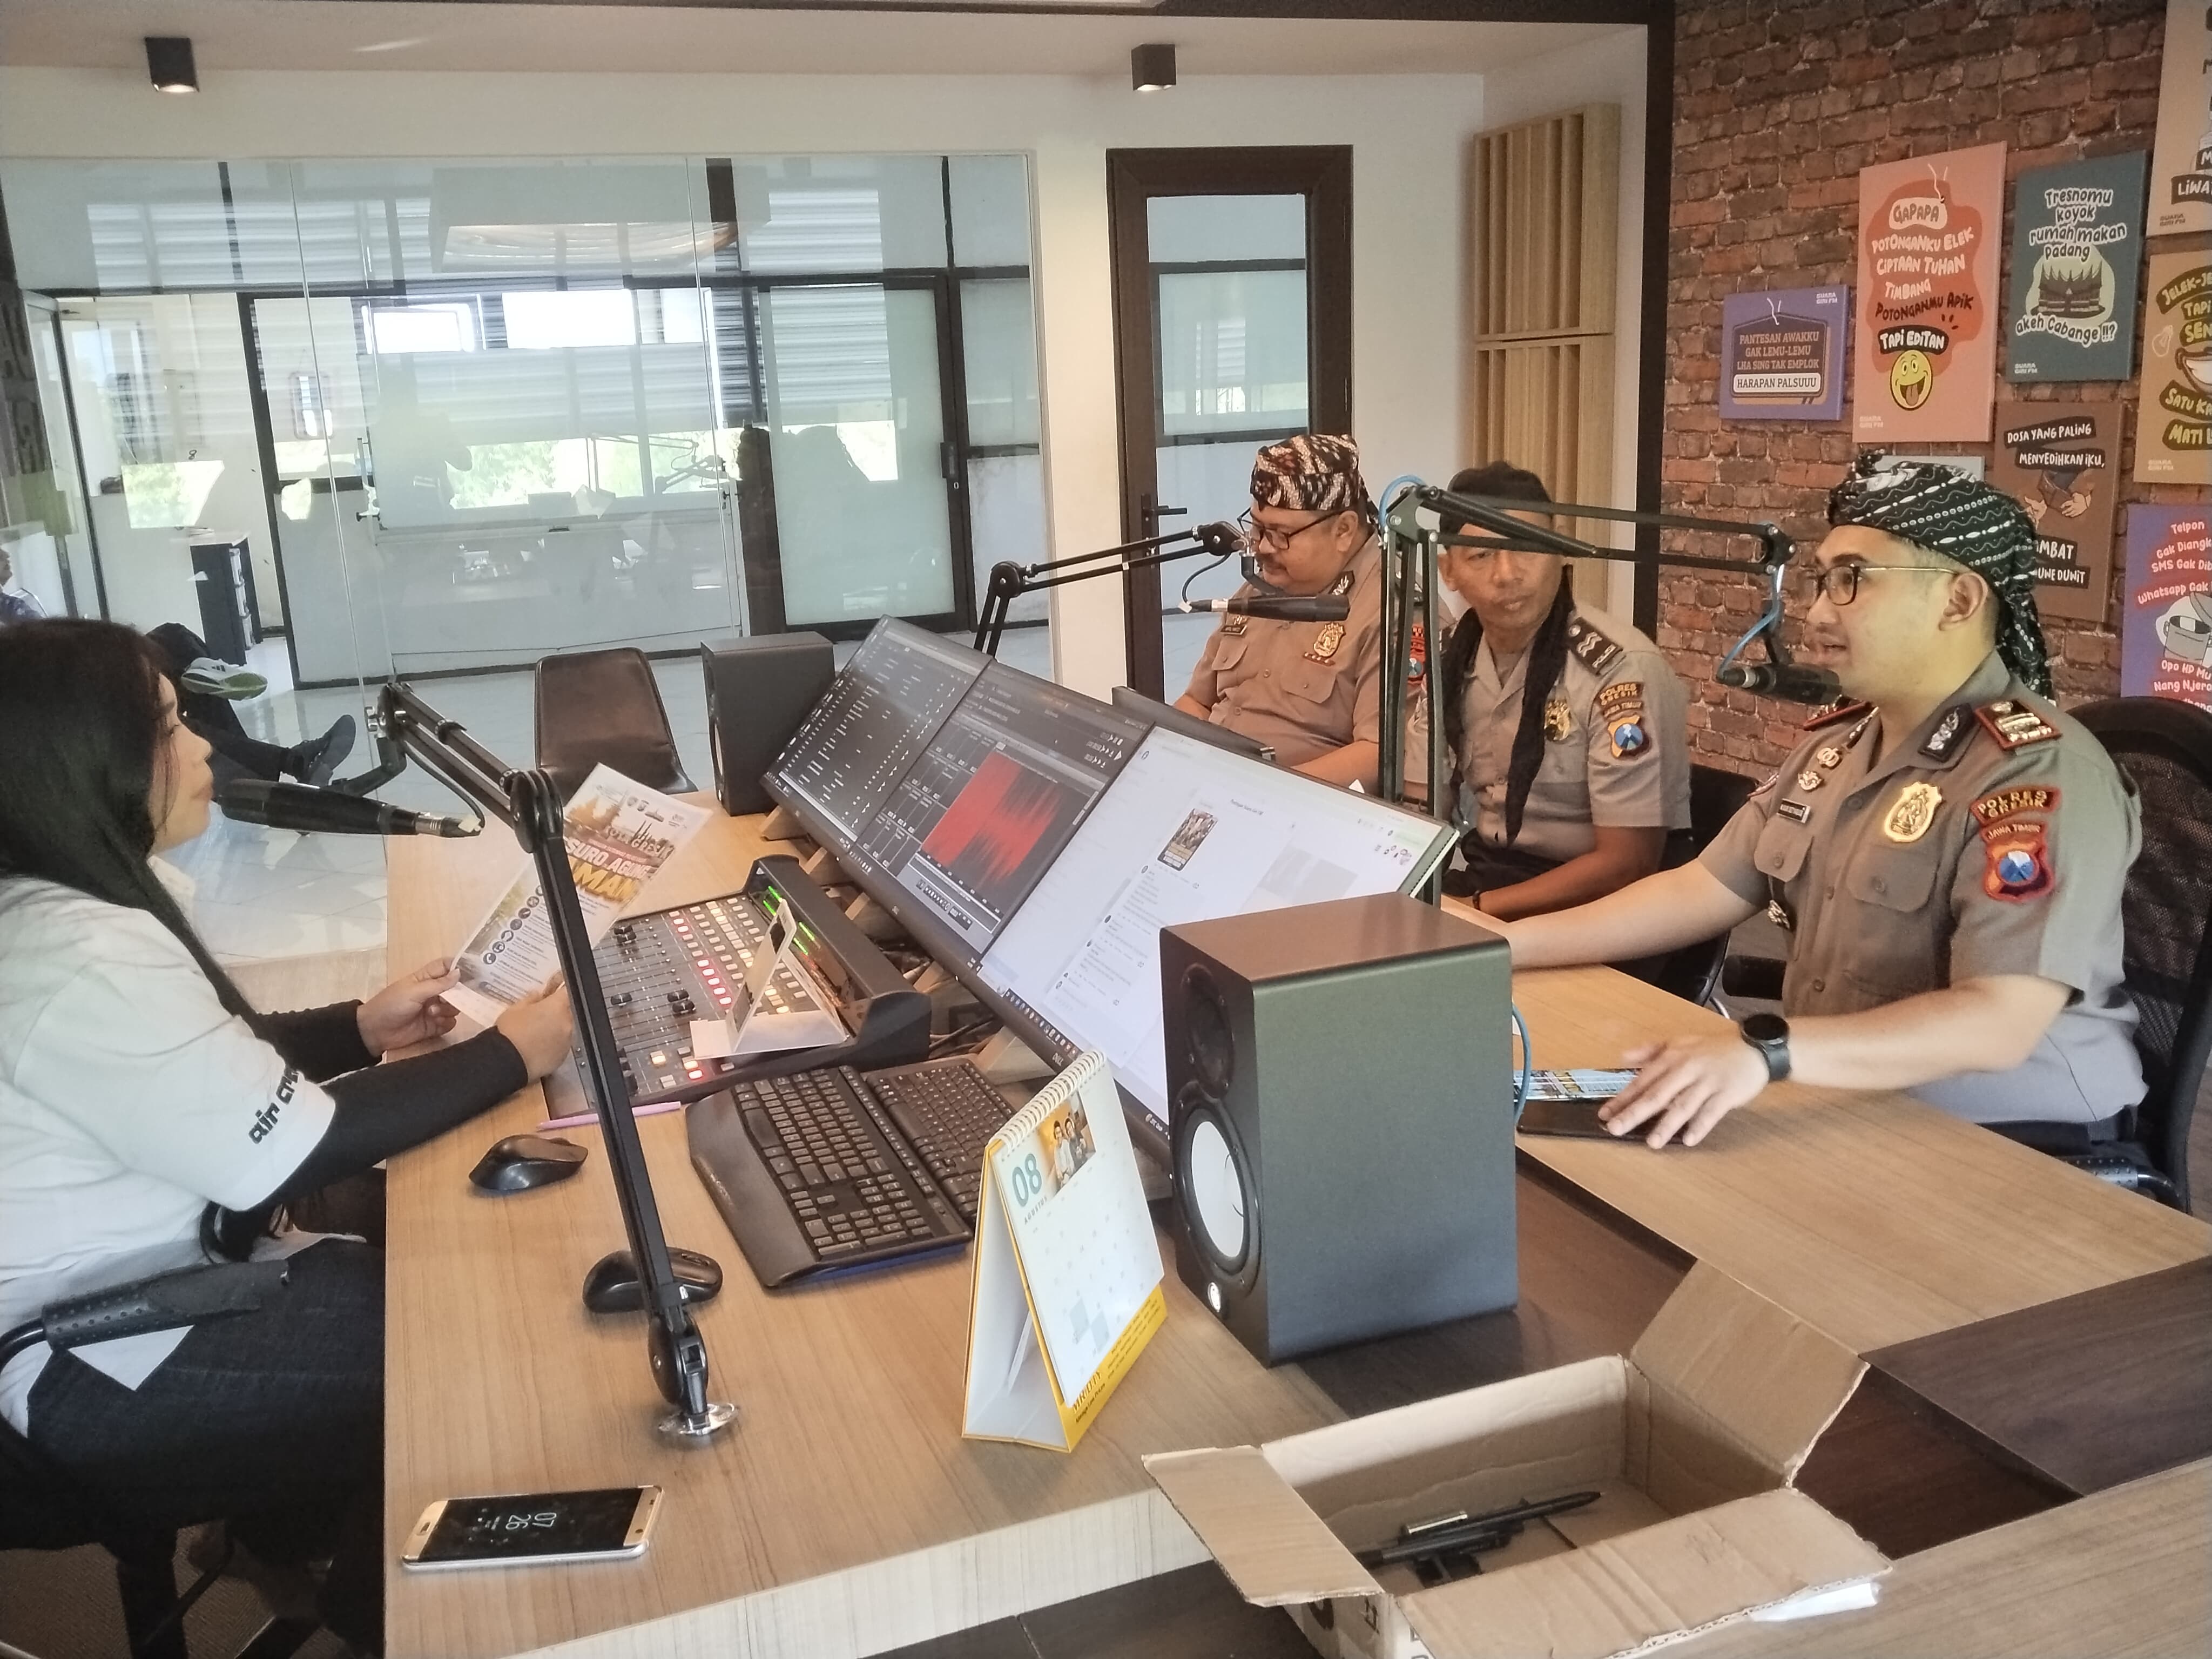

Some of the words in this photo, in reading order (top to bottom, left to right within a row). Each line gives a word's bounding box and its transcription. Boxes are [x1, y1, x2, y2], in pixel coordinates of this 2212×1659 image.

[2045, 188, 2113, 208] Tresnomu
[2056, 207, 2096, 224] koyok
[1944, 226, 1974, 251] ELEK
[2030, 226, 2074, 245] rumah
[2076, 223, 2126, 244] makan
[2045, 243, 2090, 261] padang
[1740, 333, 1782, 344] PANTESAN
[1783, 331, 1819, 342] AWAKKU
[2016, 313, 2044, 335] akeh
[2047, 315, 2099, 347] Cabange
[1745, 347, 1761, 357] GAK
[1763, 346, 1811, 357] LEMU-LEMU
[1737, 361, 1751, 370] LHA
[1753, 360, 1770, 369] SING
[1772, 360, 1785, 369] TAK
[1788, 359, 1819, 368] EMPLOK
[1737, 378, 1775, 388] HARAPAN
[1777, 377, 1817, 387] PALSUUU
[2165, 388, 2194, 410] SATU
[2007, 431, 2029, 443] DOSA
[2031, 427, 2056, 441] YANG
[2168, 424, 2203, 444] MATI
[2171, 521, 2205, 534] Telpon
[2156, 545, 2175, 559] Gak
[2035, 567, 2055, 581] UWE
[2152, 559, 2174, 572] SMS
[2176, 559, 2196, 569] Gak
[2137, 584, 2186, 604] Whatsapp
[2189, 581, 2208, 591] Gak
[2162, 660, 2179, 672] Opo
[2154, 681, 2180, 692] Nang
[1978, 791, 2047, 814] POLRES
[248, 1102, 280, 1144] air
[1011, 1153, 1042, 1208] 08
